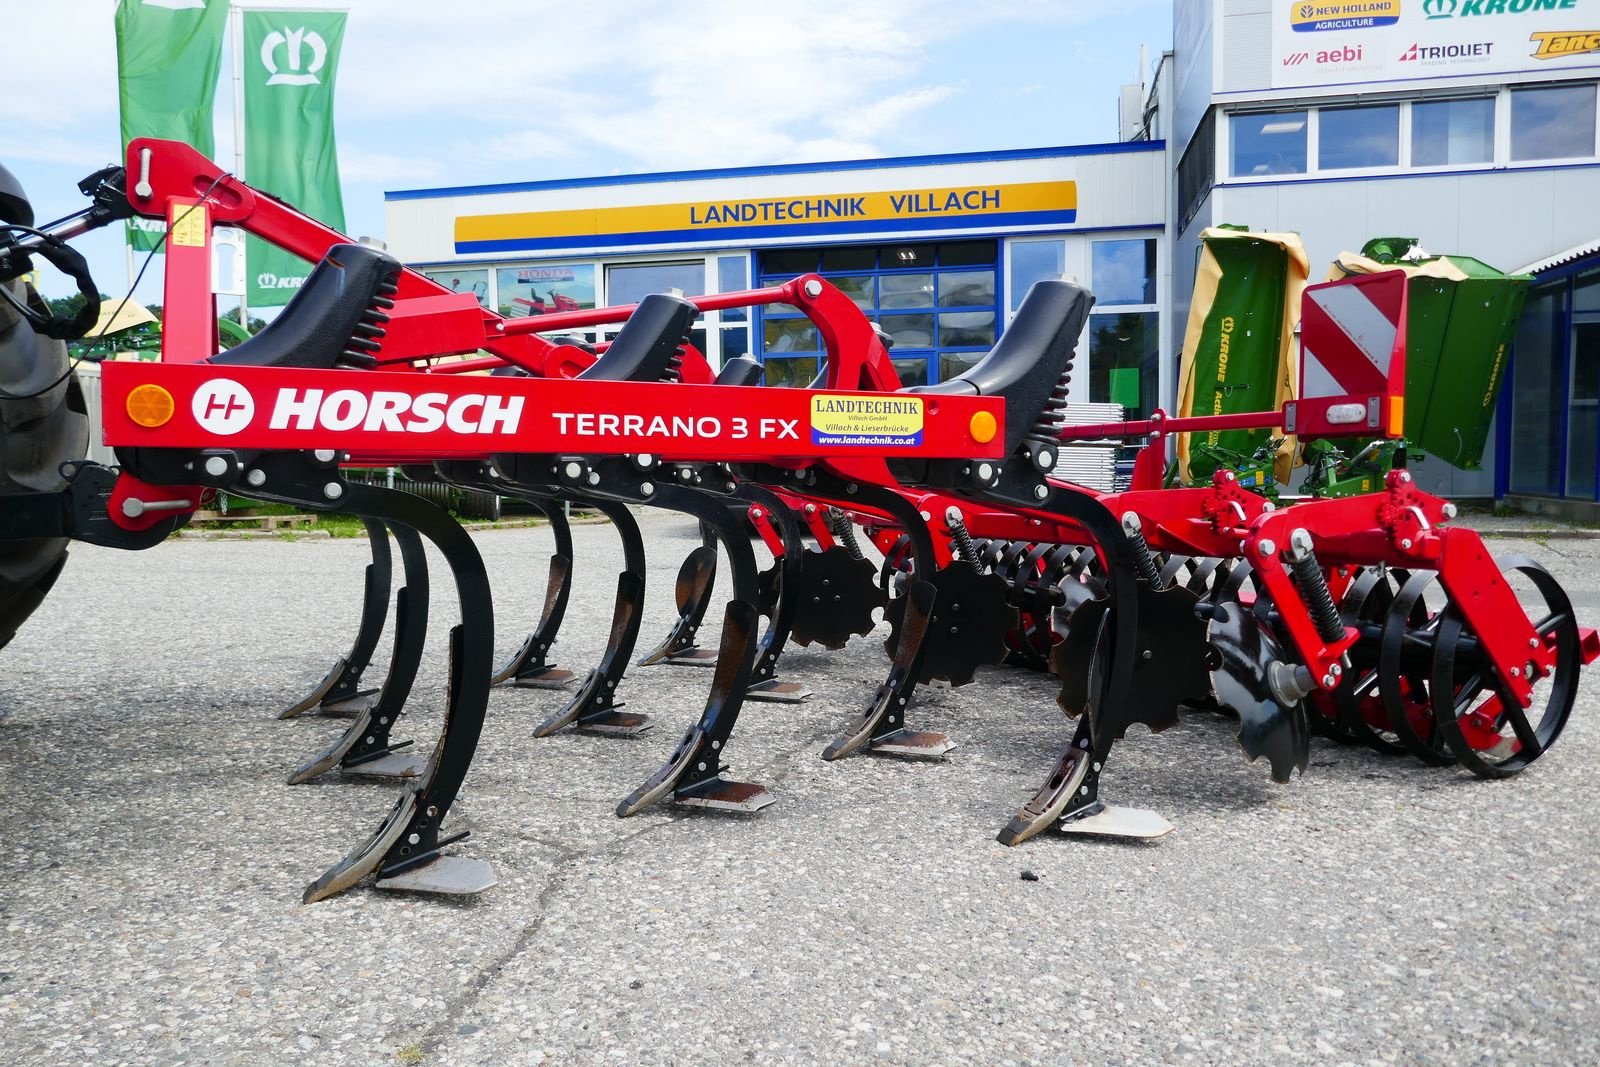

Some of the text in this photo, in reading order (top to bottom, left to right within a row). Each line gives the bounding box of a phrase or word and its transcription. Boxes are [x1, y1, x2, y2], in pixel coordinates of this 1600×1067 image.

[1316, 2, 1392, 16] NEW HOLLAND
[1315, 18, 1374, 30] AGRICULTURE
[1418, 42, 1494, 60] TRIOLIET
[1530, 31, 1600, 58] Tanc
[1316, 44, 1362, 64] aebi
[690, 189, 1000, 224] LANDTECHNIK VILLACH
[518, 268, 573, 279] HONDA
[1217, 332, 1230, 383] KRONE
[268, 387, 526, 435] HORSCH
[816, 399, 918, 415] LANDTECHNIK
[552, 412, 799, 439] TERRANO 3 FX
[825, 424, 909, 433] Villach & Lieserbrücke
[819, 436, 915, 445] www.landtechnik.co.at
